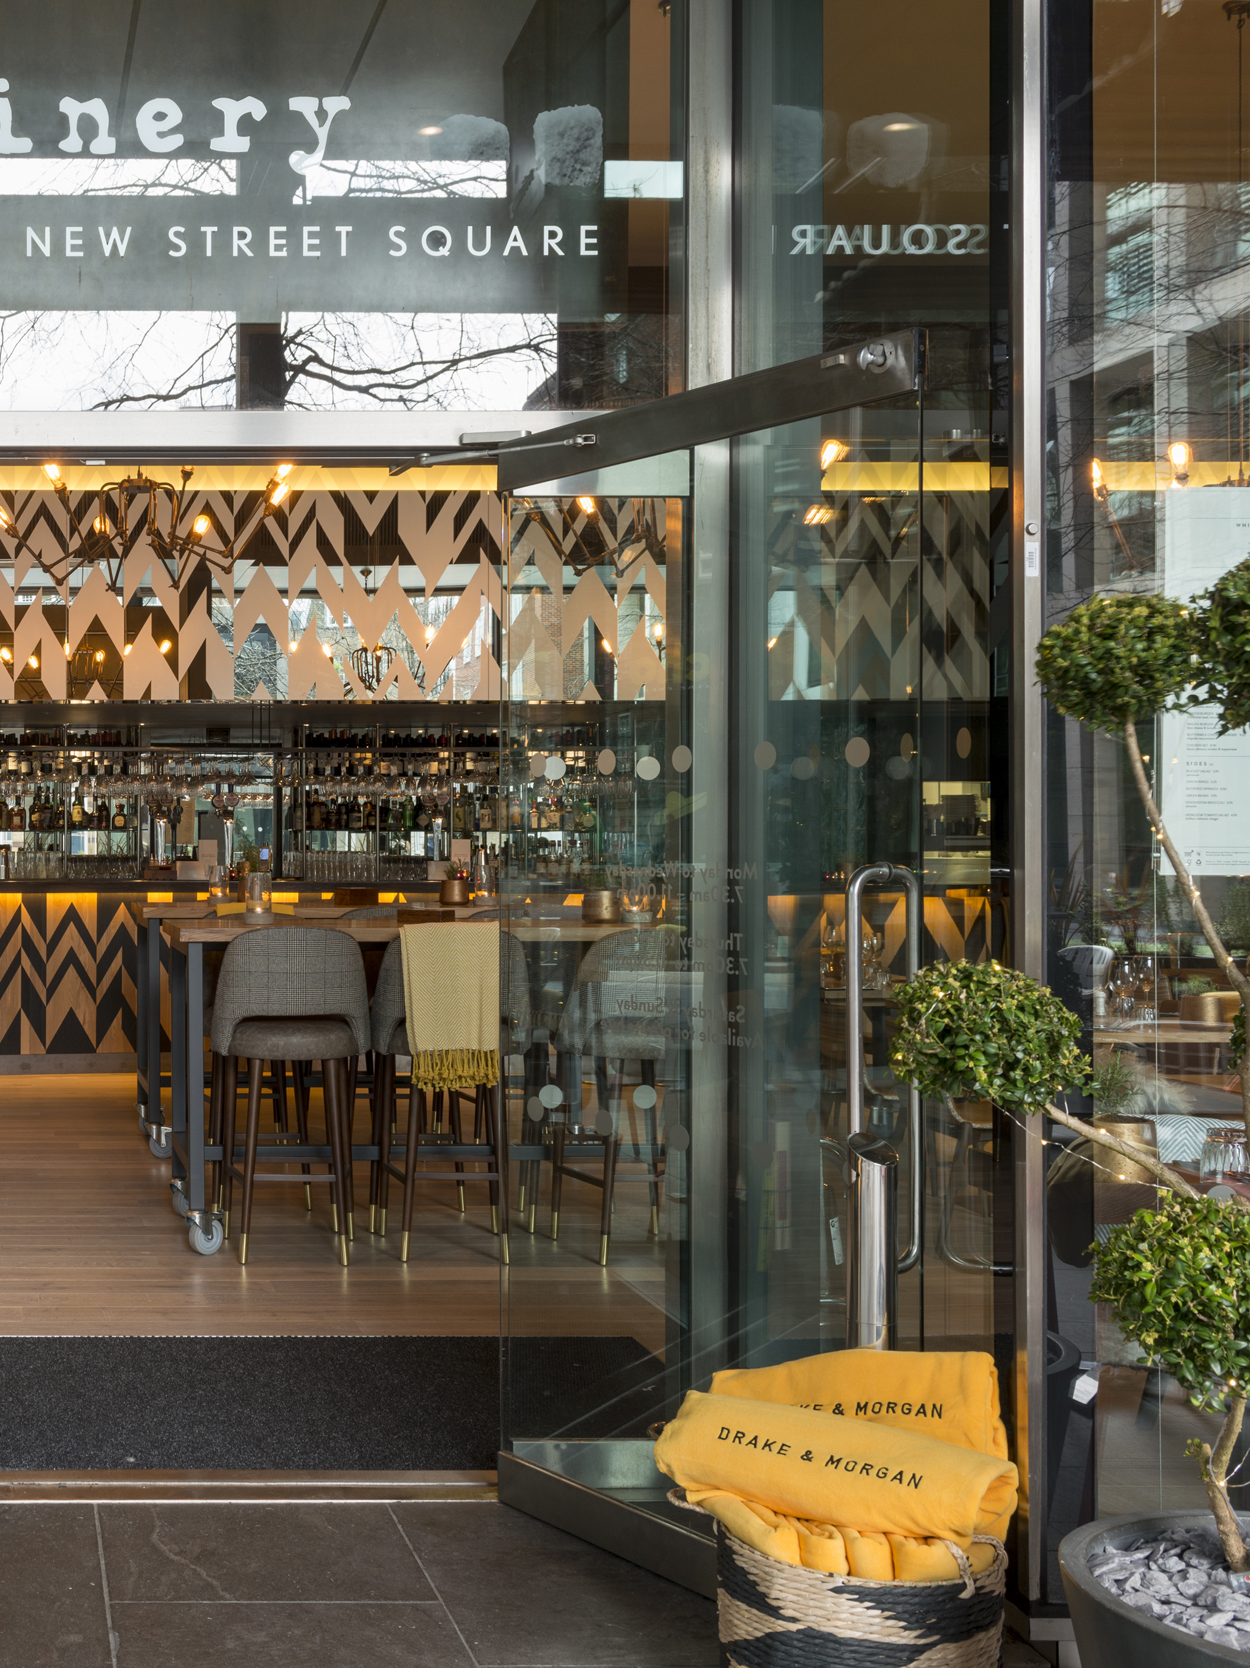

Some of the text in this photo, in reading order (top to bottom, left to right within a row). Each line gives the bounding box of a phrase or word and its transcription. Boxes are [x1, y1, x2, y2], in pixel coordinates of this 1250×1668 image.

[26, 225, 600, 257] NEW STREET SQUARE
[832, 1403, 845, 1416] &
[855, 1401, 944, 1420] MORGAN
[718, 1426, 924, 1490] DRAKE & MORGAN
